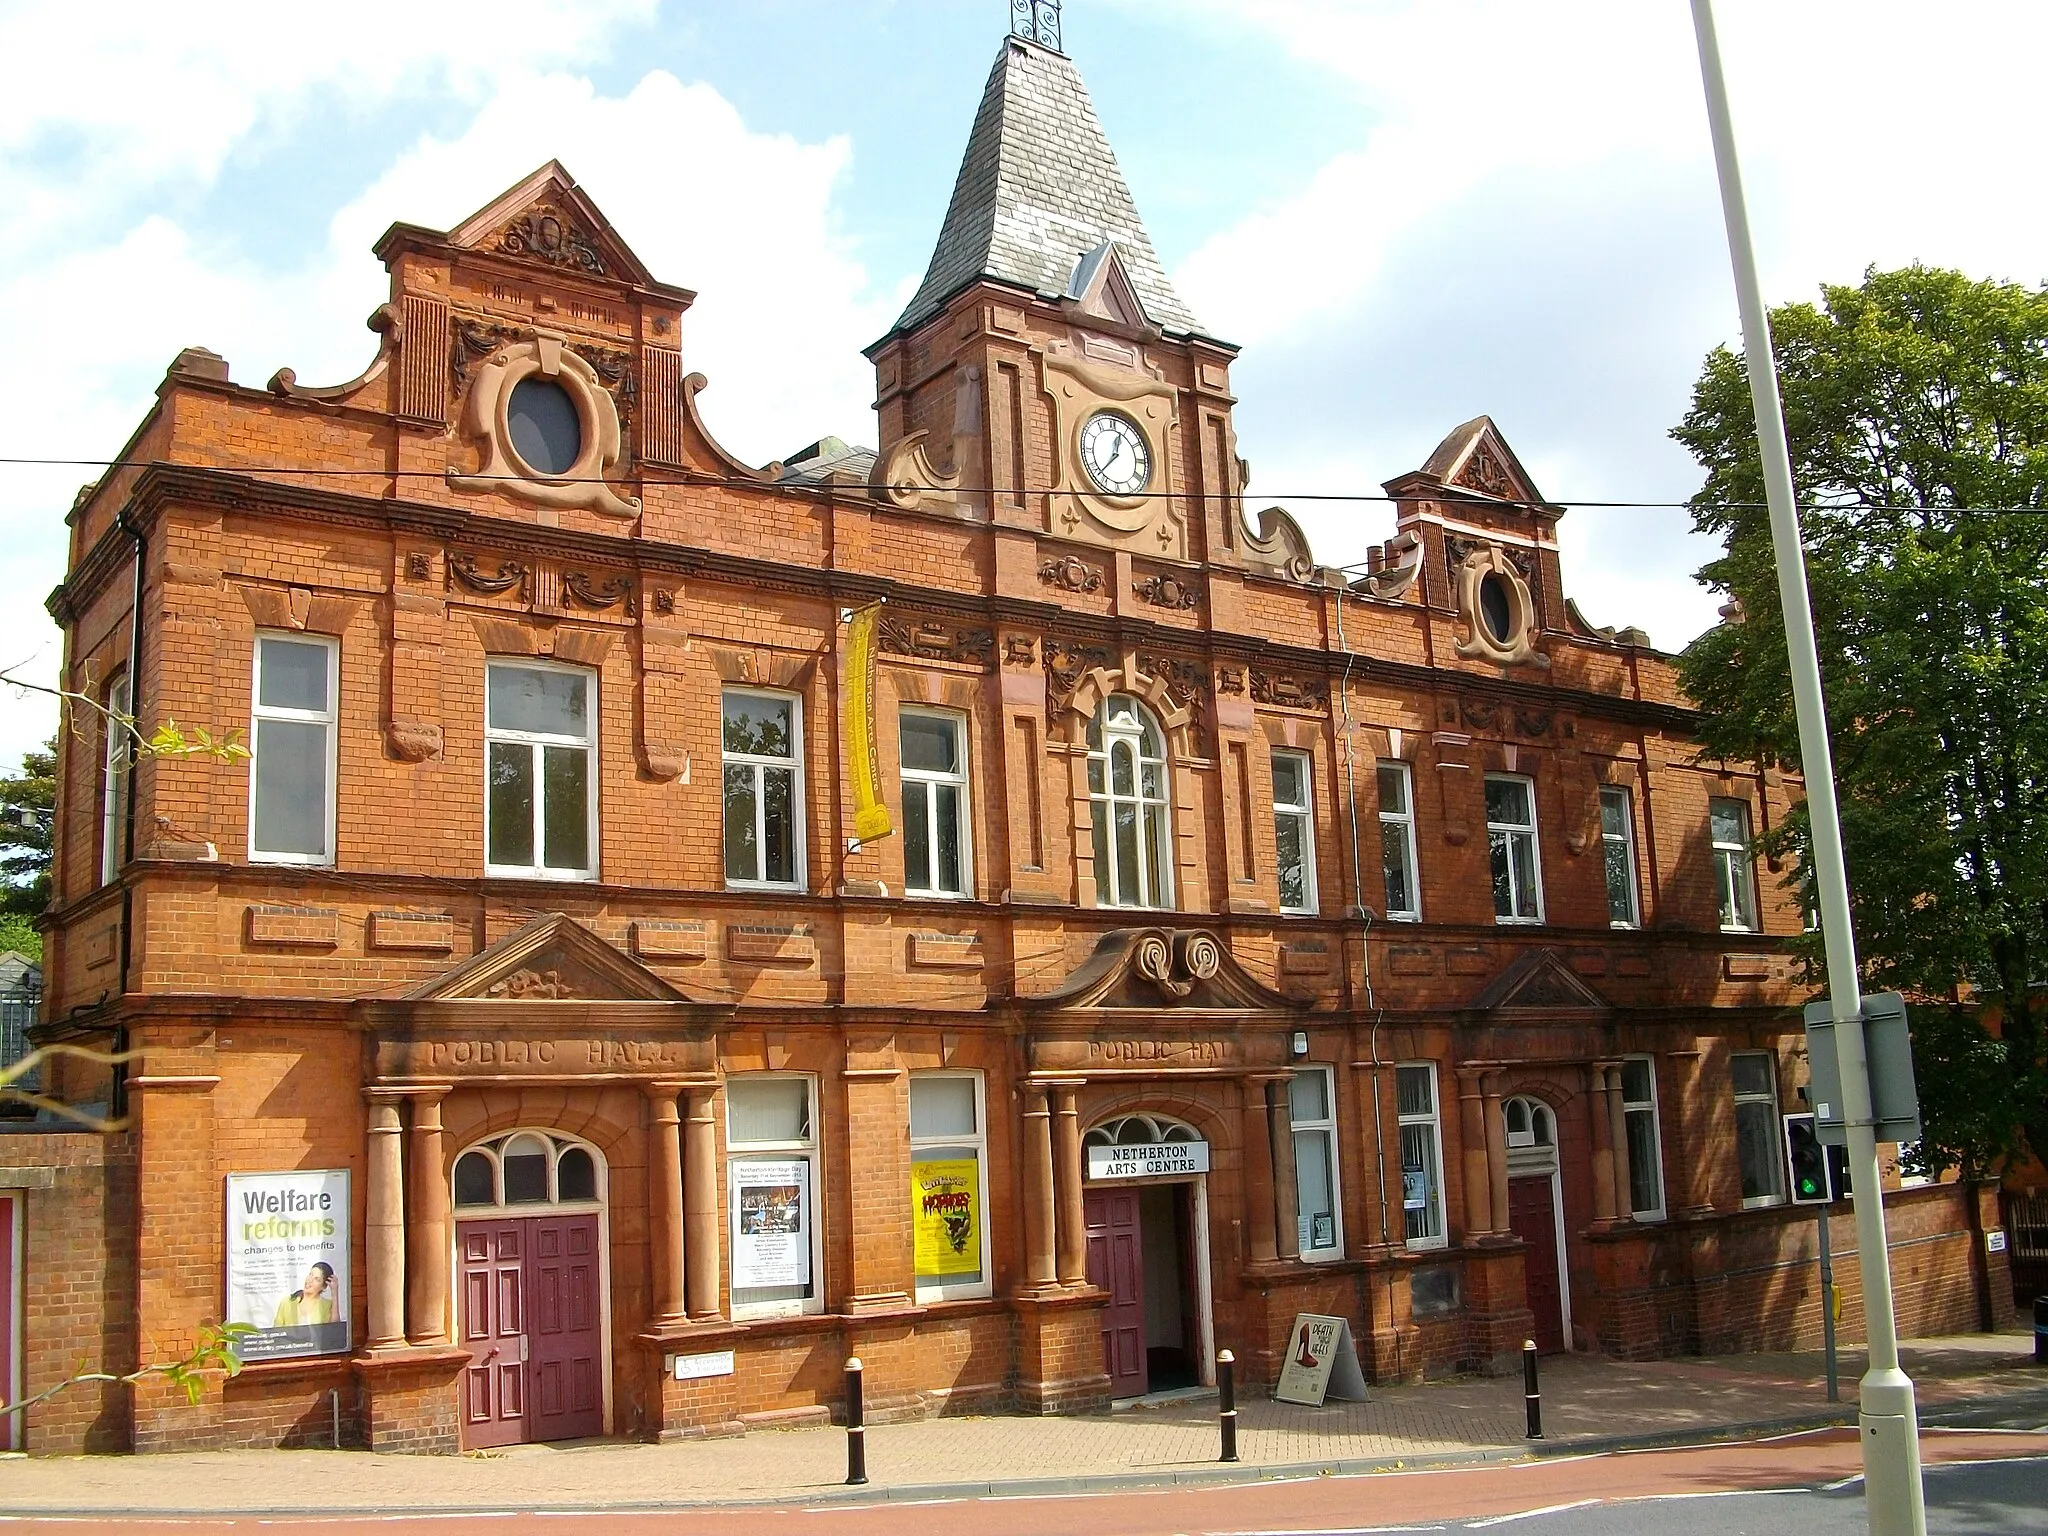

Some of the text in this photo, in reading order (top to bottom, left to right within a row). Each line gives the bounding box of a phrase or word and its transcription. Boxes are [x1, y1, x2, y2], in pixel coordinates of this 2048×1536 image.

[866, 646, 879, 792] Netherton Arts Centre
[430, 1040, 676, 1066] PUBLIC HALL
[1088, 1041, 1172, 1061] PUBLIC
[1112, 1145, 1188, 1161] NETHERTON
[1105, 1159, 1196, 1176] ARTS CENTRE
[243, 1189, 332, 1214] Welfare
[243, 1216, 335, 1241] reforms
[243, 1241, 335, 1255] changes to benefits
[1312, 1323, 1335, 1337] DEATH
